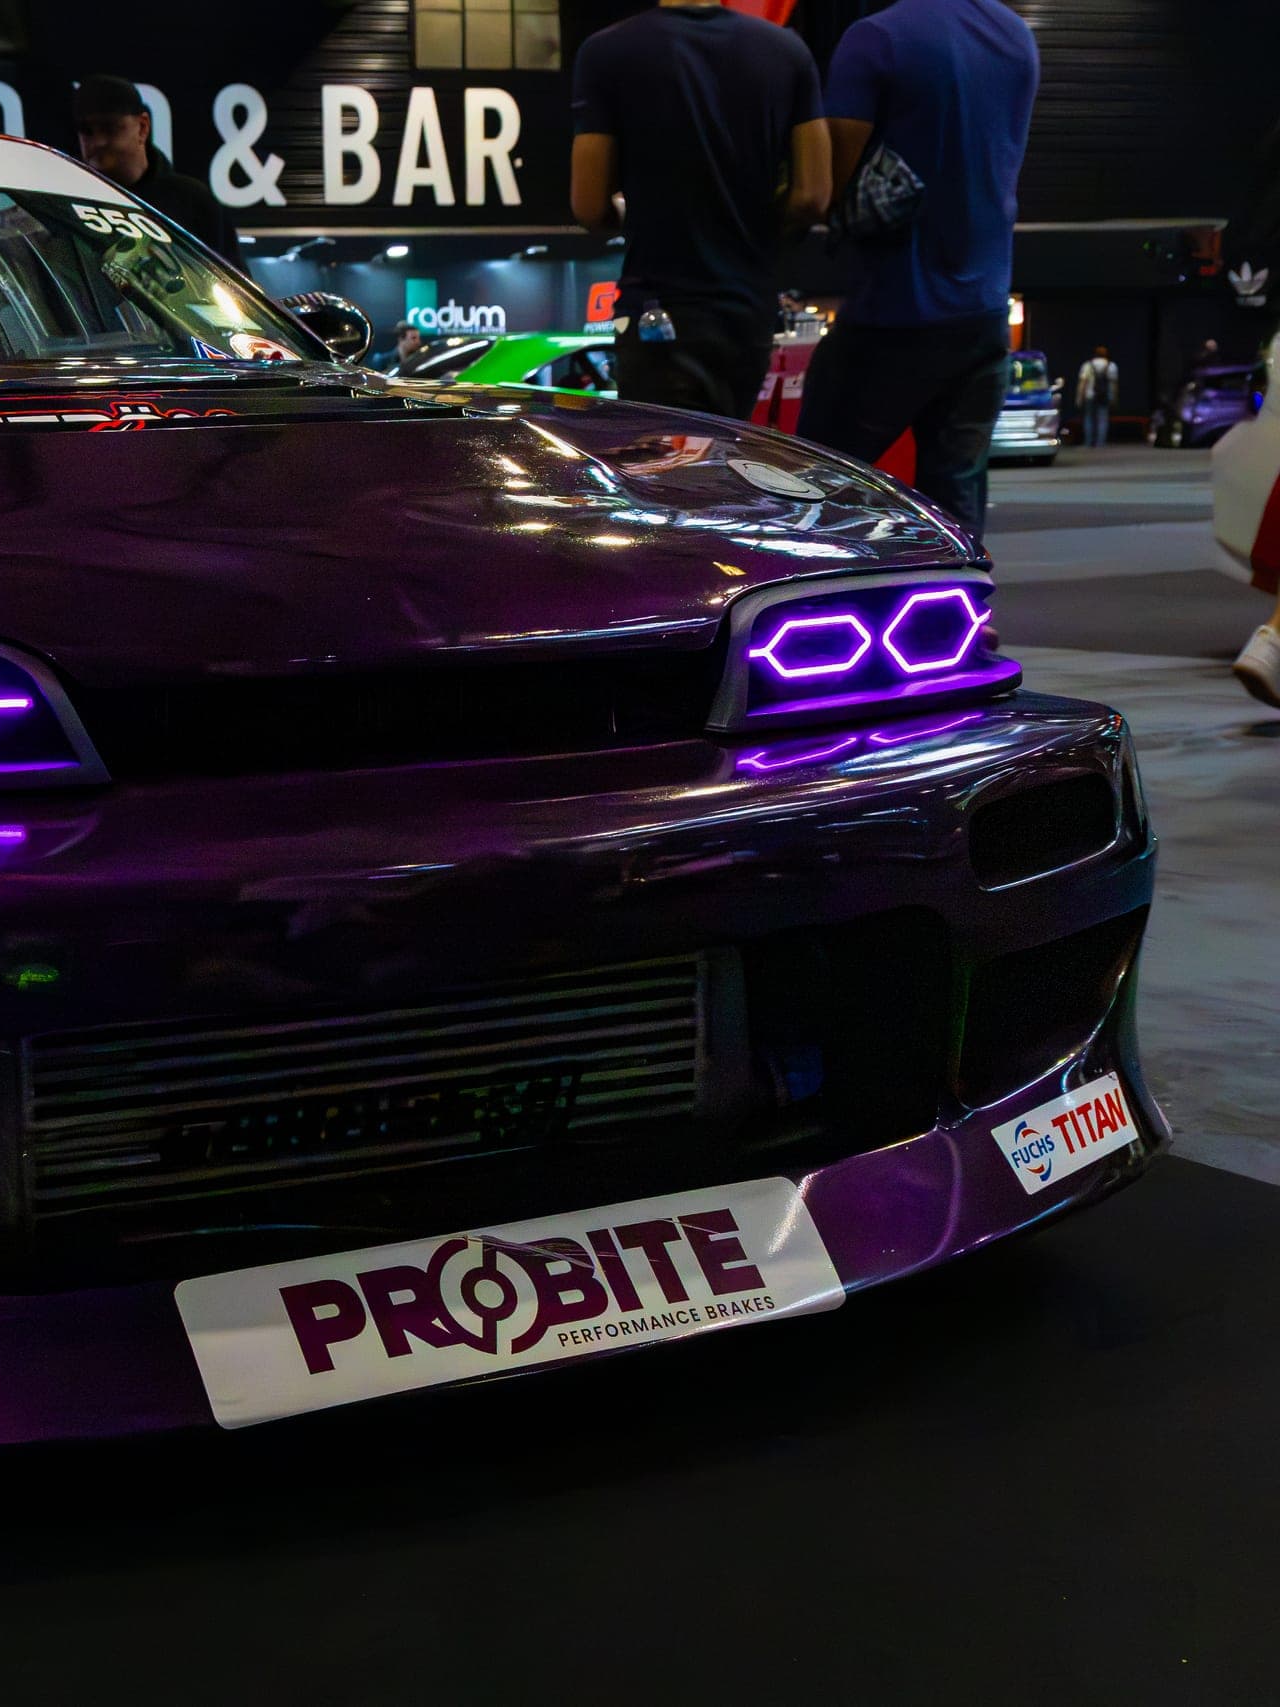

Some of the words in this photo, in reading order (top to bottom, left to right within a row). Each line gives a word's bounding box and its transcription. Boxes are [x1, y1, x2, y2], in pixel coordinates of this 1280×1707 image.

[209, 83, 288, 207] &
[321, 84, 522, 206] BAR
[71, 203, 173, 243] 550
[407, 298, 506, 329] radium
[1011, 1134, 1055, 1169] FUCHS
[1051, 1088, 1128, 1155] TITAN
[278, 1207, 767, 1376] PROBITE
[557, 1308, 701, 1348] PERFORMANCE
[706, 1295, 776, 1320] BRAKES
